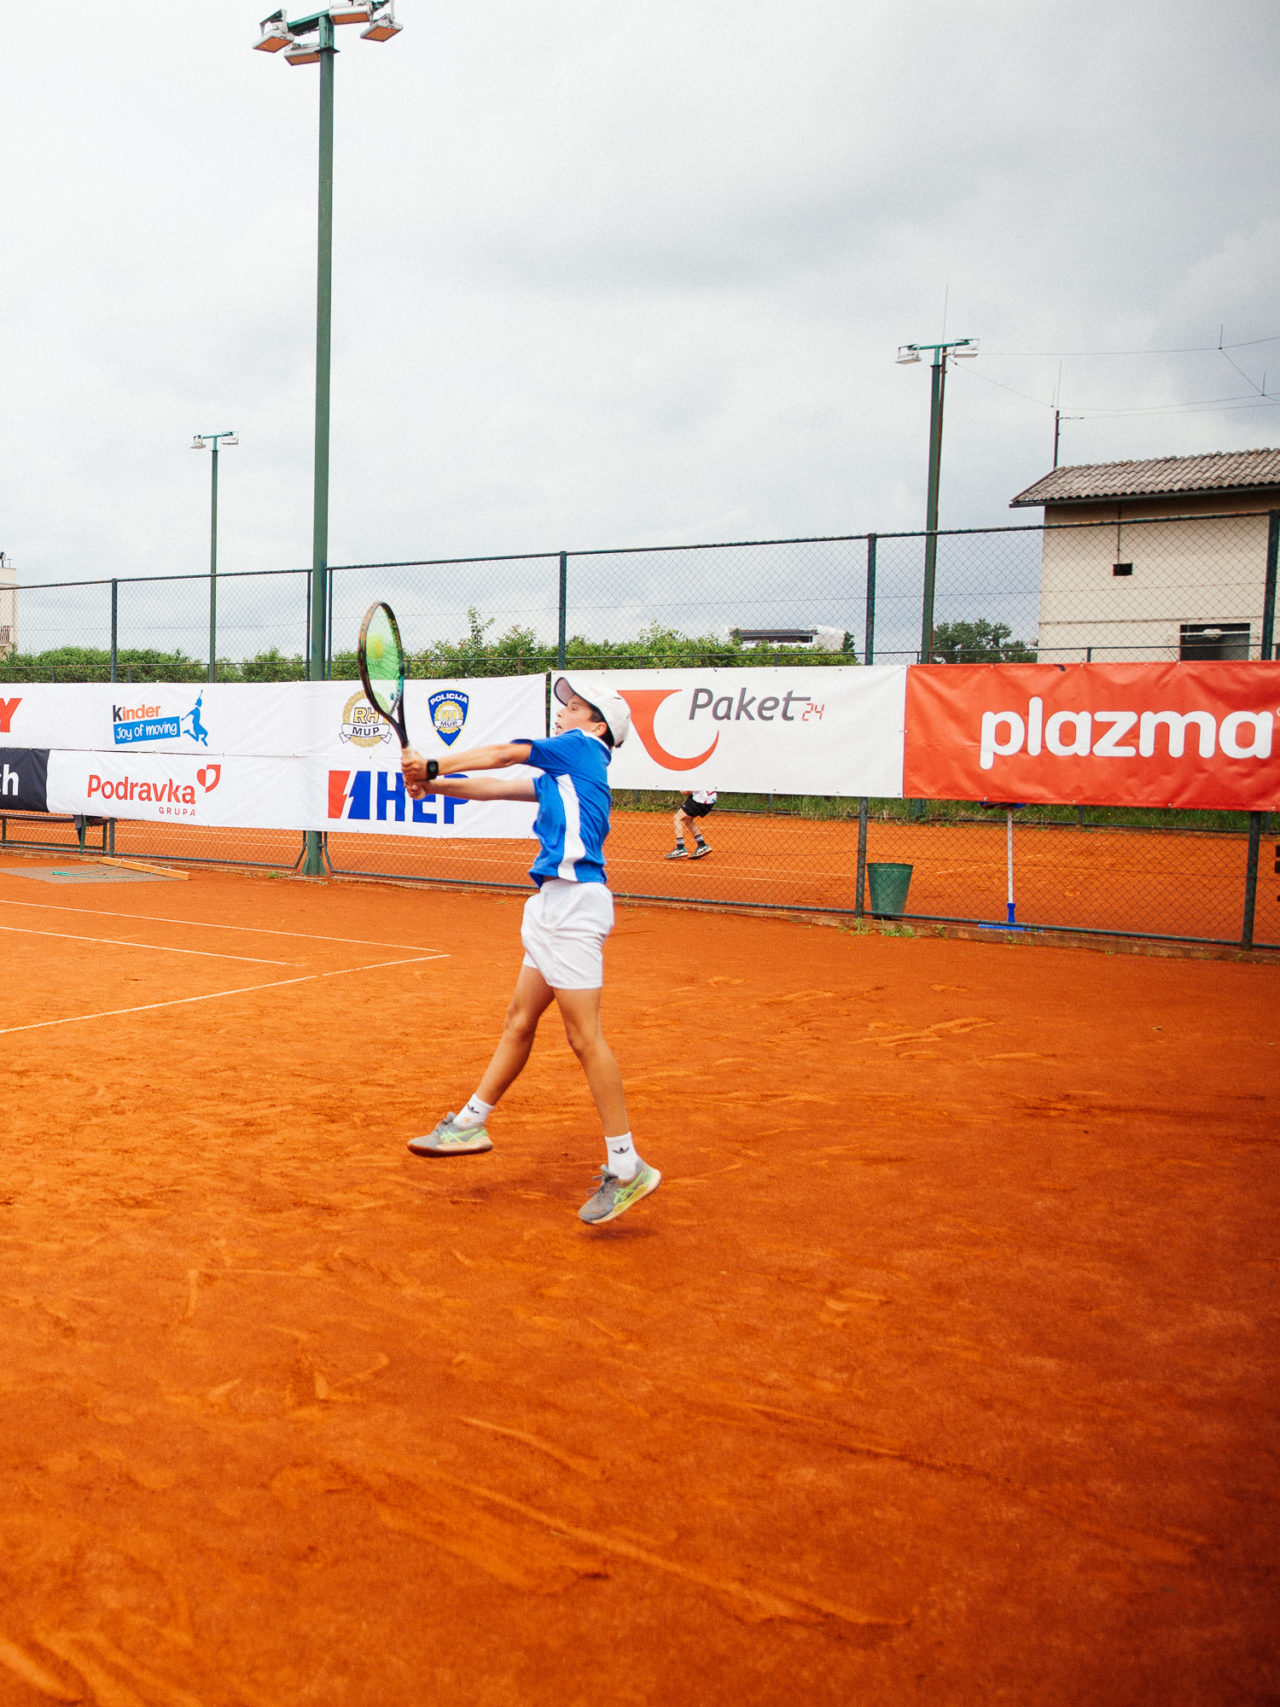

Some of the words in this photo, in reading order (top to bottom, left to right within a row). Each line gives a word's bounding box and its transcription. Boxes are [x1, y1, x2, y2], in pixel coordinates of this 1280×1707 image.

[430, 693, 468, 705] POLICIJA
[688, 687, 811, 721] Paket
[802, 704, 825, 721] 24
[353, 707, 379, 724] RH
[134, 724, 144, 736] of
[145, 722, 177, 736] moving
[352, 727, 379, 736] MUP
[980, 696, 1274, 770] plazma
[88, 774, 196, 805] Podravka
[159, 807, 196, 816] GRUPA
